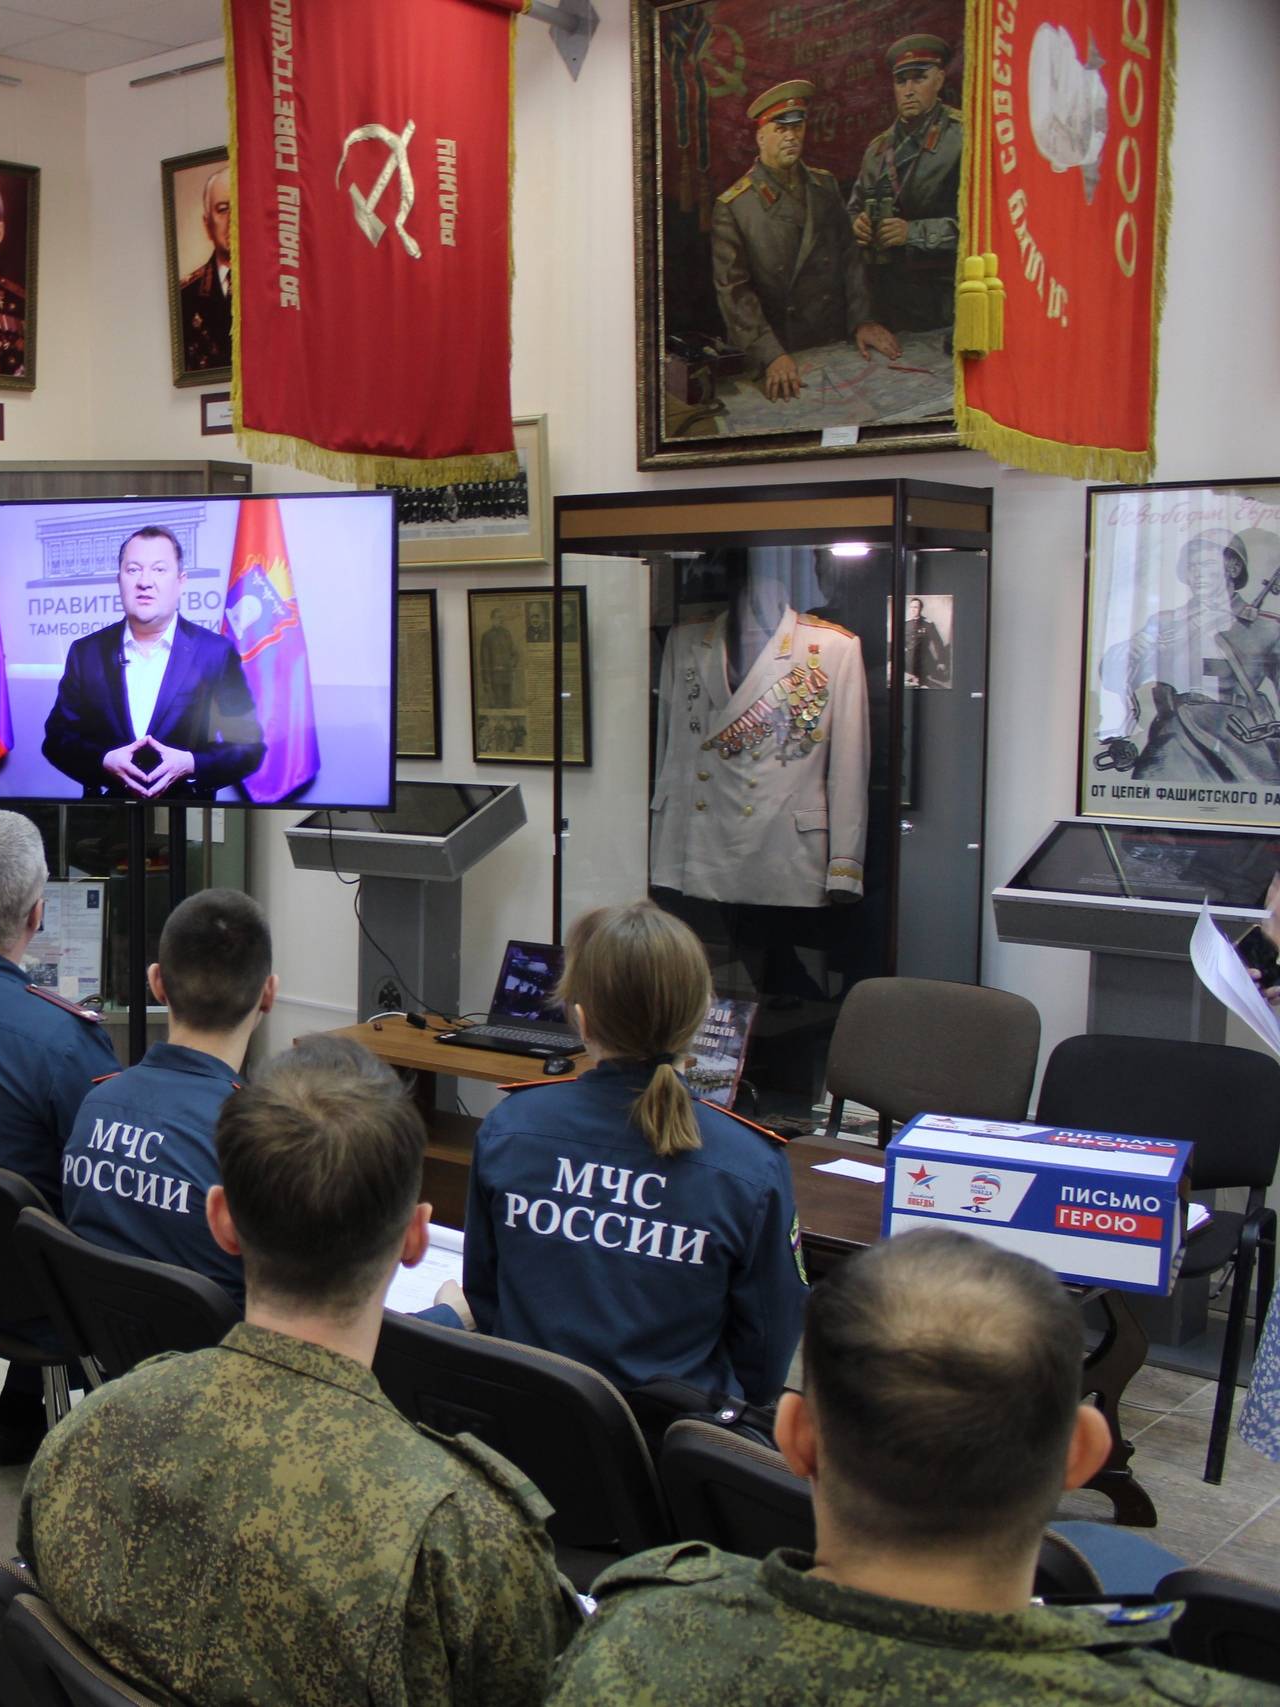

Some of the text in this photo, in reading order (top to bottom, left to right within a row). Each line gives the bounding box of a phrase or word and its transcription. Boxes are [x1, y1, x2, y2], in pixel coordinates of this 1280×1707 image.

[270, 0, 301, 311] ЗА НАШУ СОВЕТСКУЮ
[435, 138, 460, 247] РОДИНУ
[28, 591, 222, 616] ПРАВИТЕТВО
[30, 621, 111, 637] ТАМБОВСК
[1091, 784, 1107, 798] ОТ
[1112, 785, 1151, 800] ЦЕПЕЙ
[1156, 787, 1258, 805] ФАШИСТСКОГО
[87, 1118, 165, 1164] МЧС
[1053, 1136, 1147, 1151] ГЕРОЮ
[1057, 1131, 1178, 1148] ПИСЬМО
[62, 1154, 193, 1214] РОССИИ
[552, 1157, 667, 1210] МЧС
[1061, 1185, 1161, 1213] ПИСЬМО
[504, 1192, 711, 1265] РОССИИ
[1059, 1208, 1137, 1233] ГЕРОЮ
